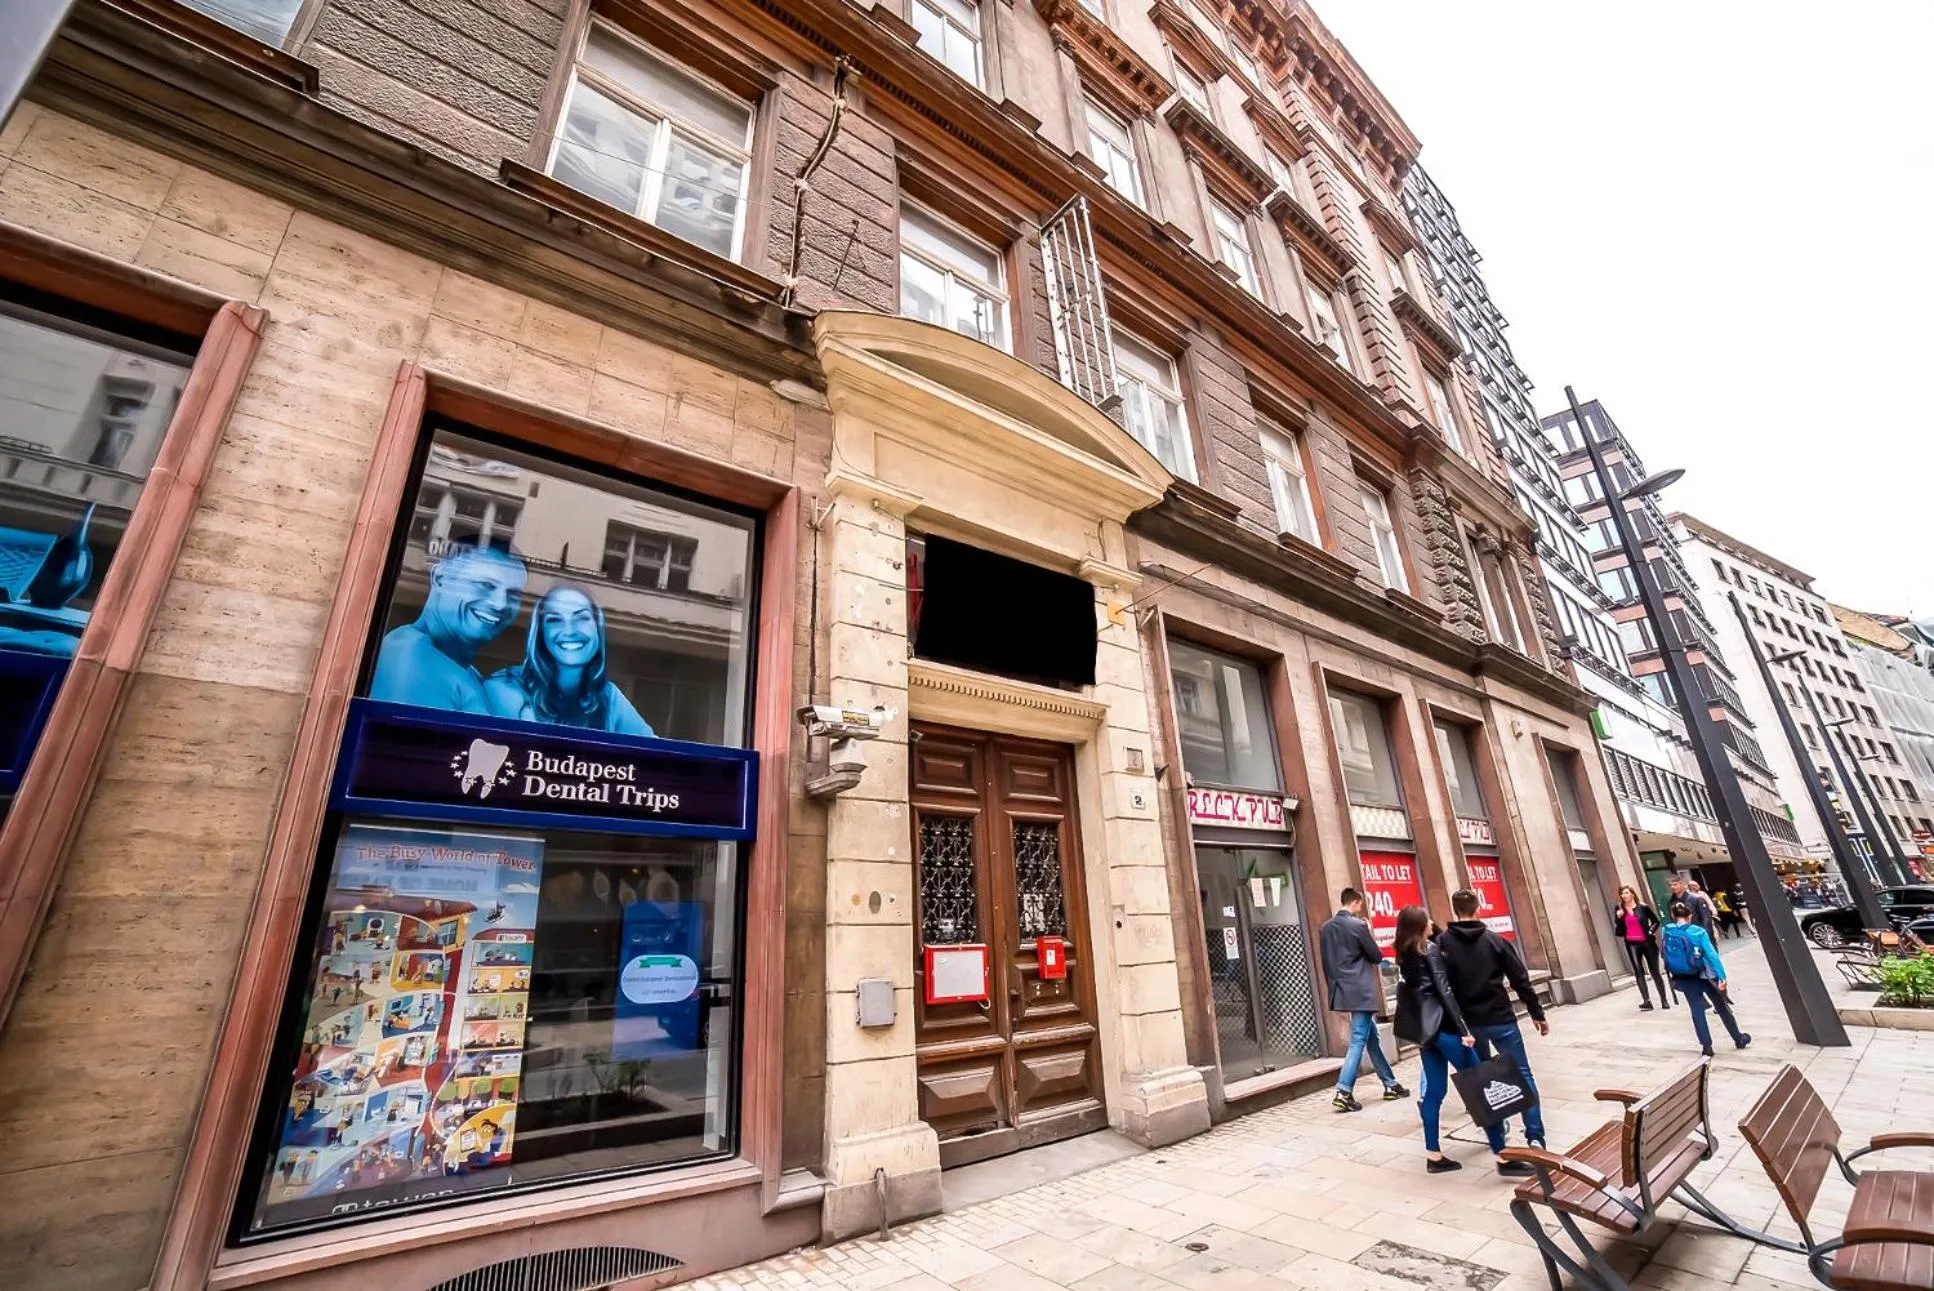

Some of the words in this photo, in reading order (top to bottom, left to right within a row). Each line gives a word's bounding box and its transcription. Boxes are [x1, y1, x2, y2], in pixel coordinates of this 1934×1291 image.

[526, 750, 637, 782] Budapest
[522, 775, 610, 803] Dental
[616, 784, 680, 813] Trips
[1134, 795, 1143, 806] 2
[391, 845, 425, 864] Busy
[432, 847, 473, 863] World
[1380, 864, 1395, 881] TO
[1394, 865, 1411, 881] LET
